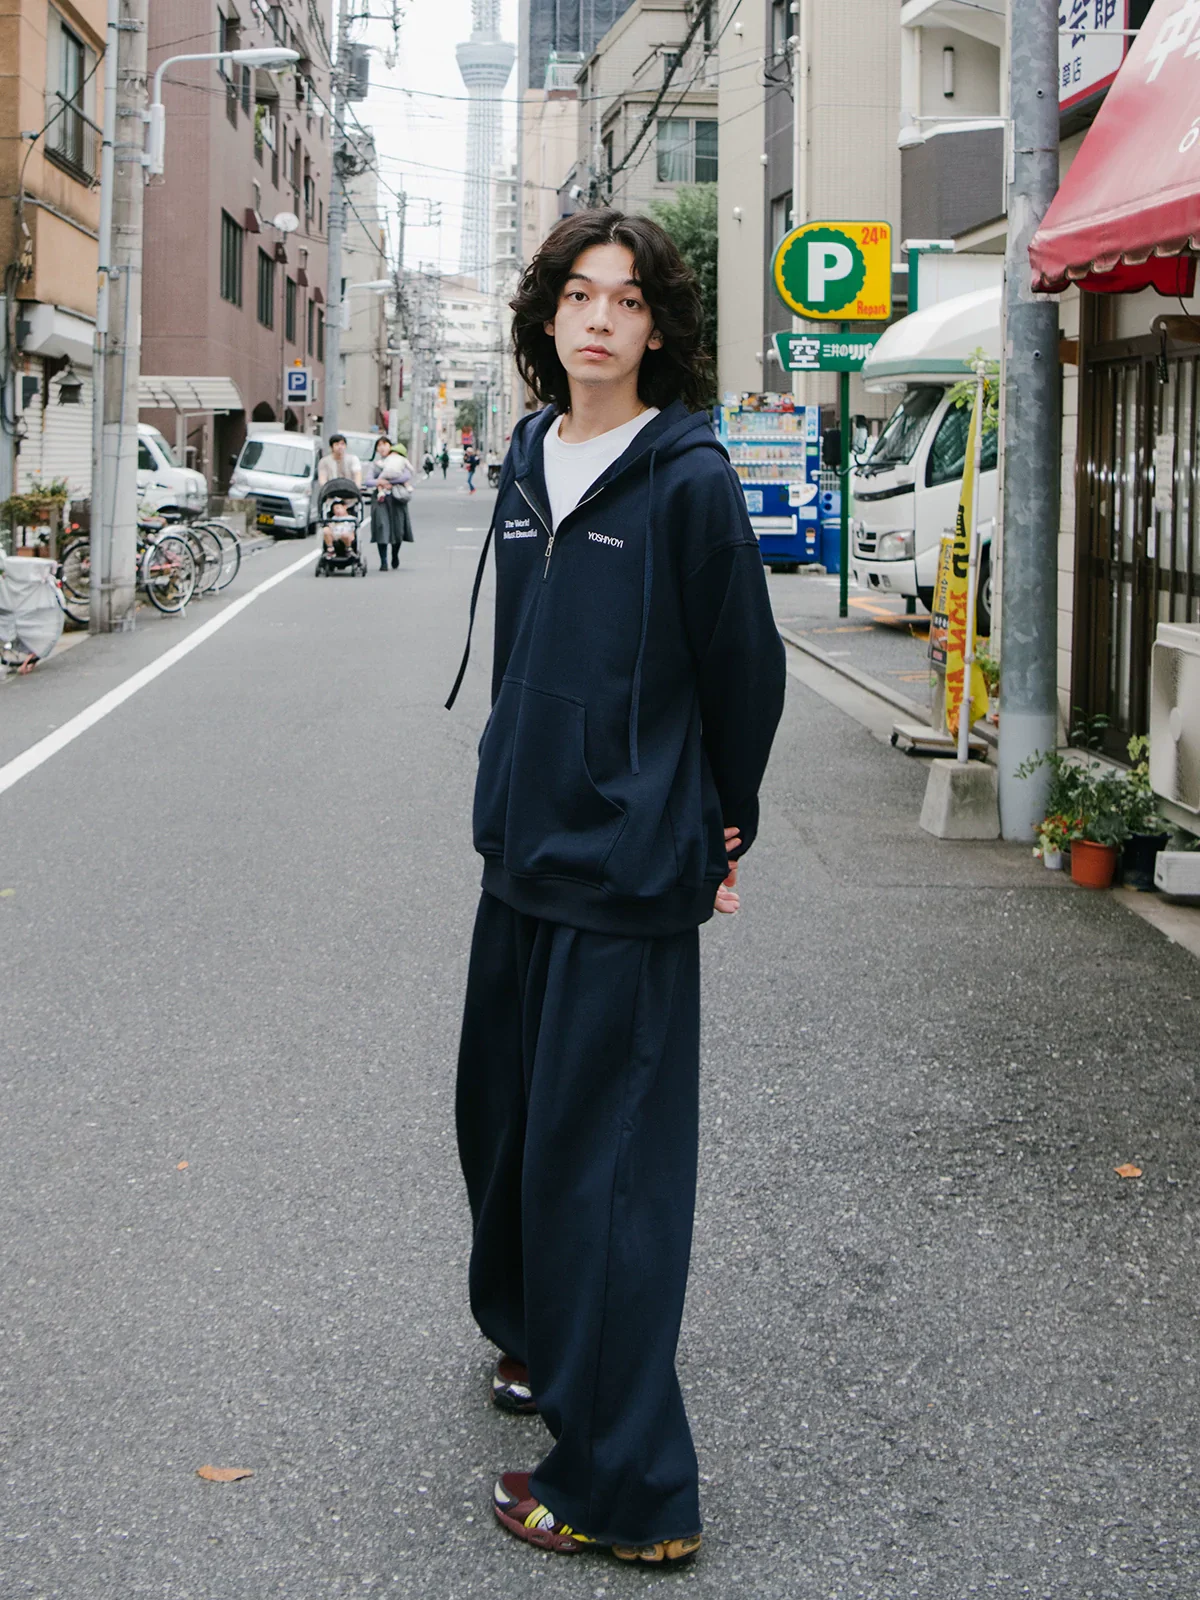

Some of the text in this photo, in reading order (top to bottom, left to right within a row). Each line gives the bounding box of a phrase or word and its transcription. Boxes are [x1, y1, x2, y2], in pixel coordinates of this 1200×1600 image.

[861, 226, 887, 245] 24h
[807, 242, 853, 302] P
[857, 300, 887, 316] Repark
[789, 336, 820, 368] 空
[291, 374, 304, 390] P
[504, 518, 530, 528] The World
[516, 529, 537, 538] Beautiful
